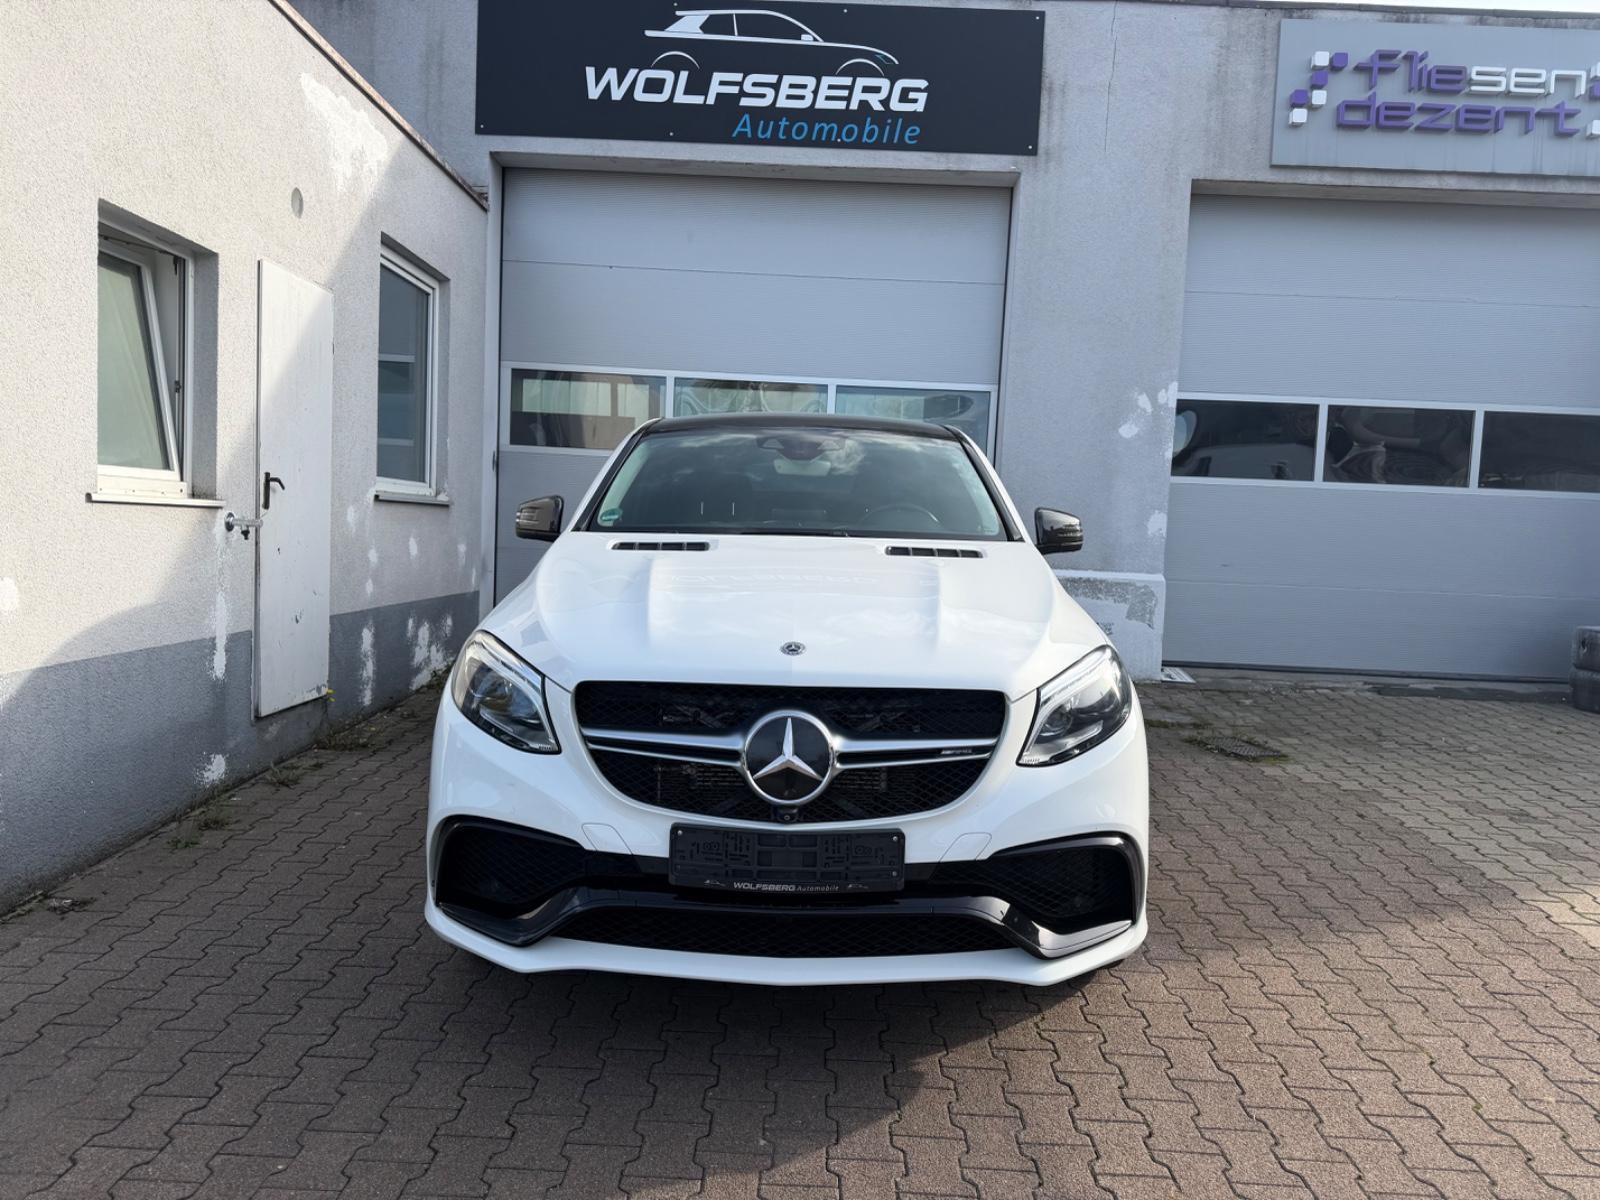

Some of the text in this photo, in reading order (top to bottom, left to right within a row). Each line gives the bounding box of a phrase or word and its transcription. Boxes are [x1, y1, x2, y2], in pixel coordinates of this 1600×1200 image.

[585, 66, 929, 113] WOLFSBERG
[1353, 49, 1587, 98] fliesen
[731, 113, 922, 145] Automobile
[1336, 91, 1582, 137] dezent
[733, 881, 796, 892] WOLFSBERG
